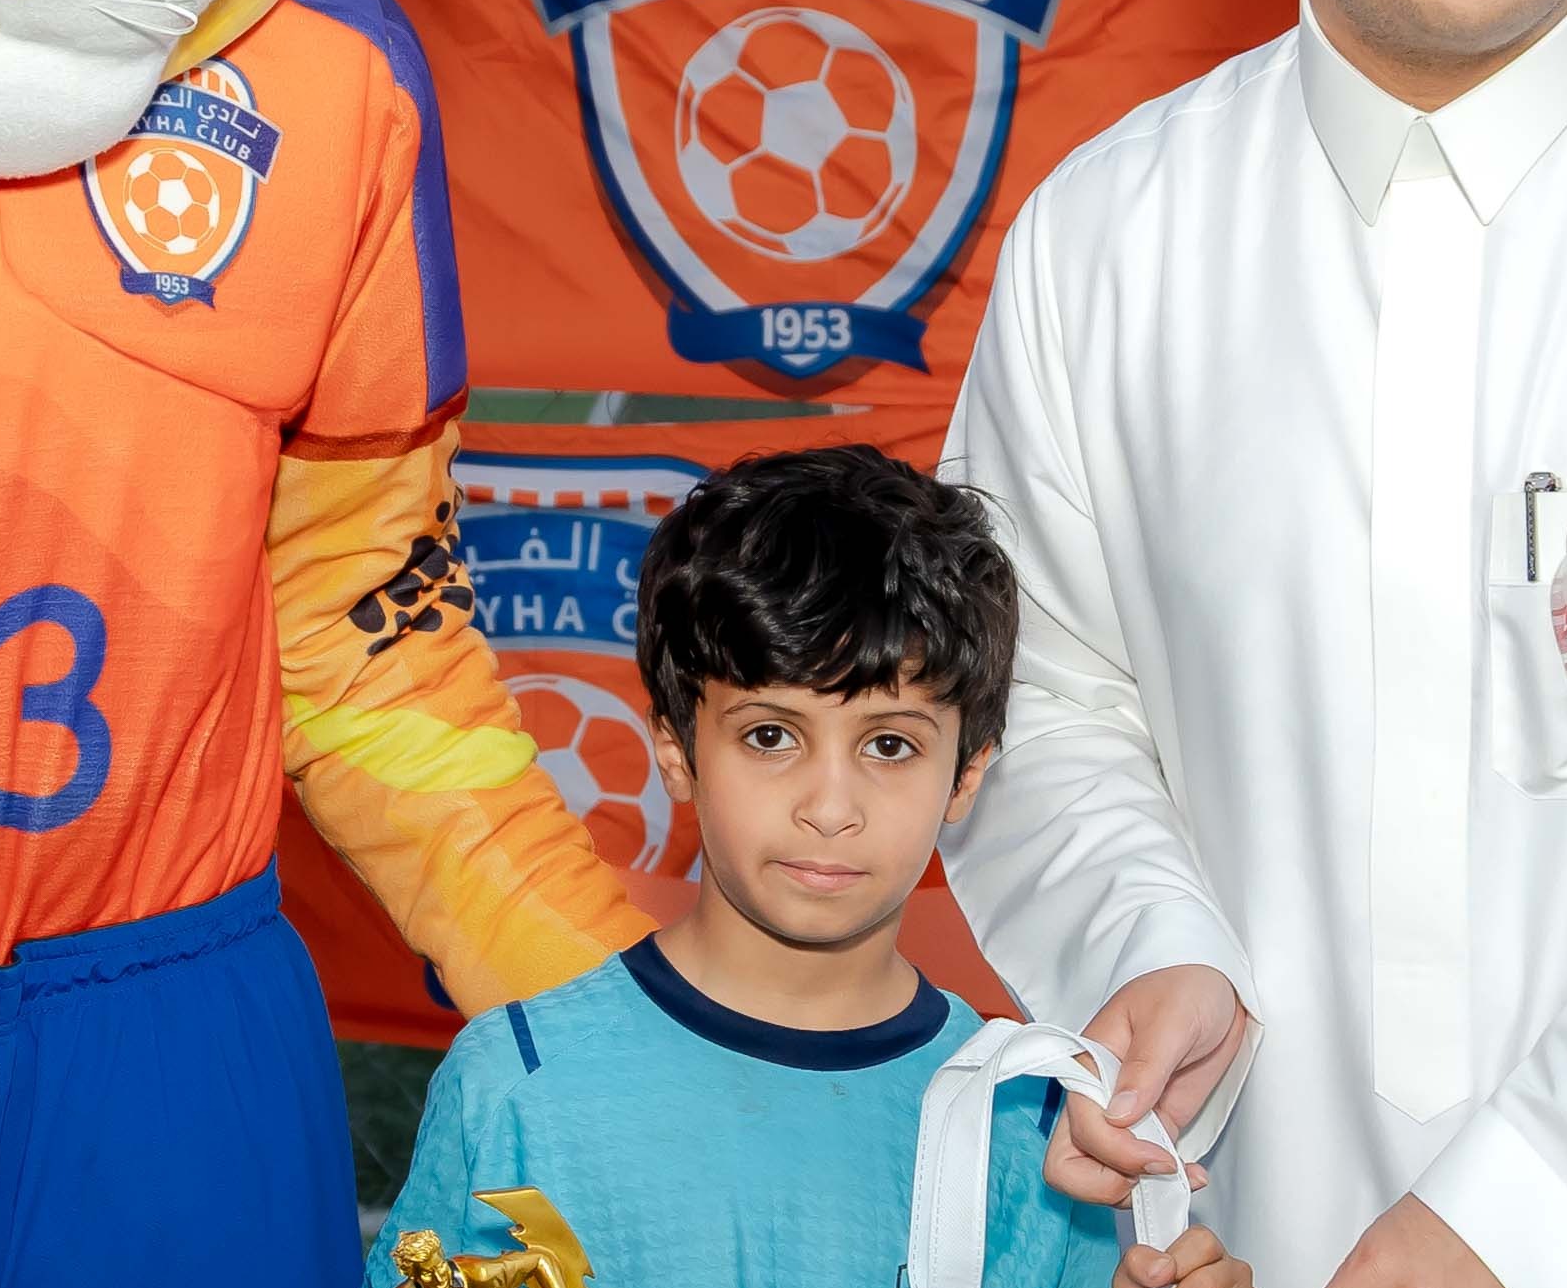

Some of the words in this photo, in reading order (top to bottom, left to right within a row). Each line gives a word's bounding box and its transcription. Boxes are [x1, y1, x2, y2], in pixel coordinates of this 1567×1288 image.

[197, 104, 262, 140] نادي
[195, 123, 252, 160] CLUB
[155, 273, 190, 295] 1953
[760, 307, 852, 350] 1953
